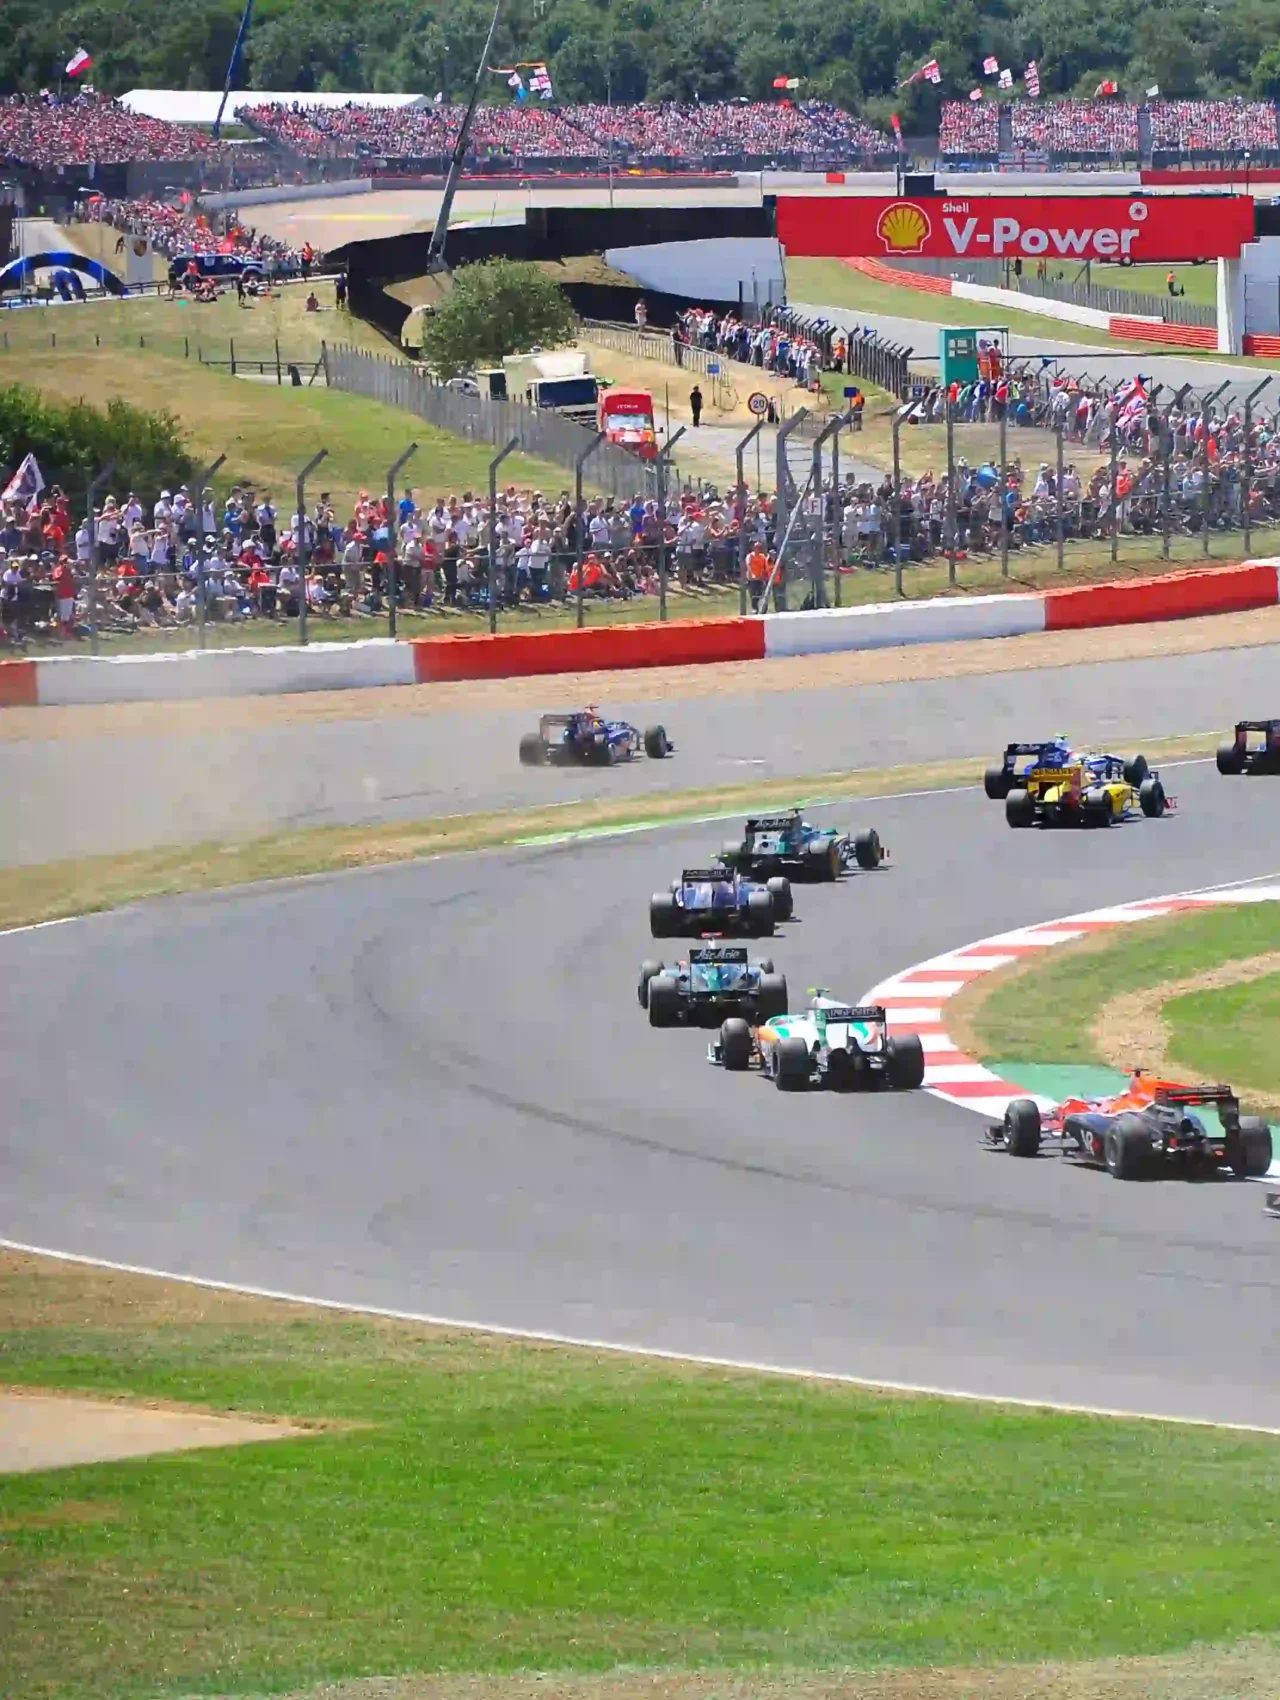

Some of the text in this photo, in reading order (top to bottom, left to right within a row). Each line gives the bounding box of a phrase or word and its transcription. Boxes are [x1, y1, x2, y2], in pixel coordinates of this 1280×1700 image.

[942, 203, 969, 213] Shell
[943, 217, 1139, 254] V-Power
[753, 400, 765, 408] 20
